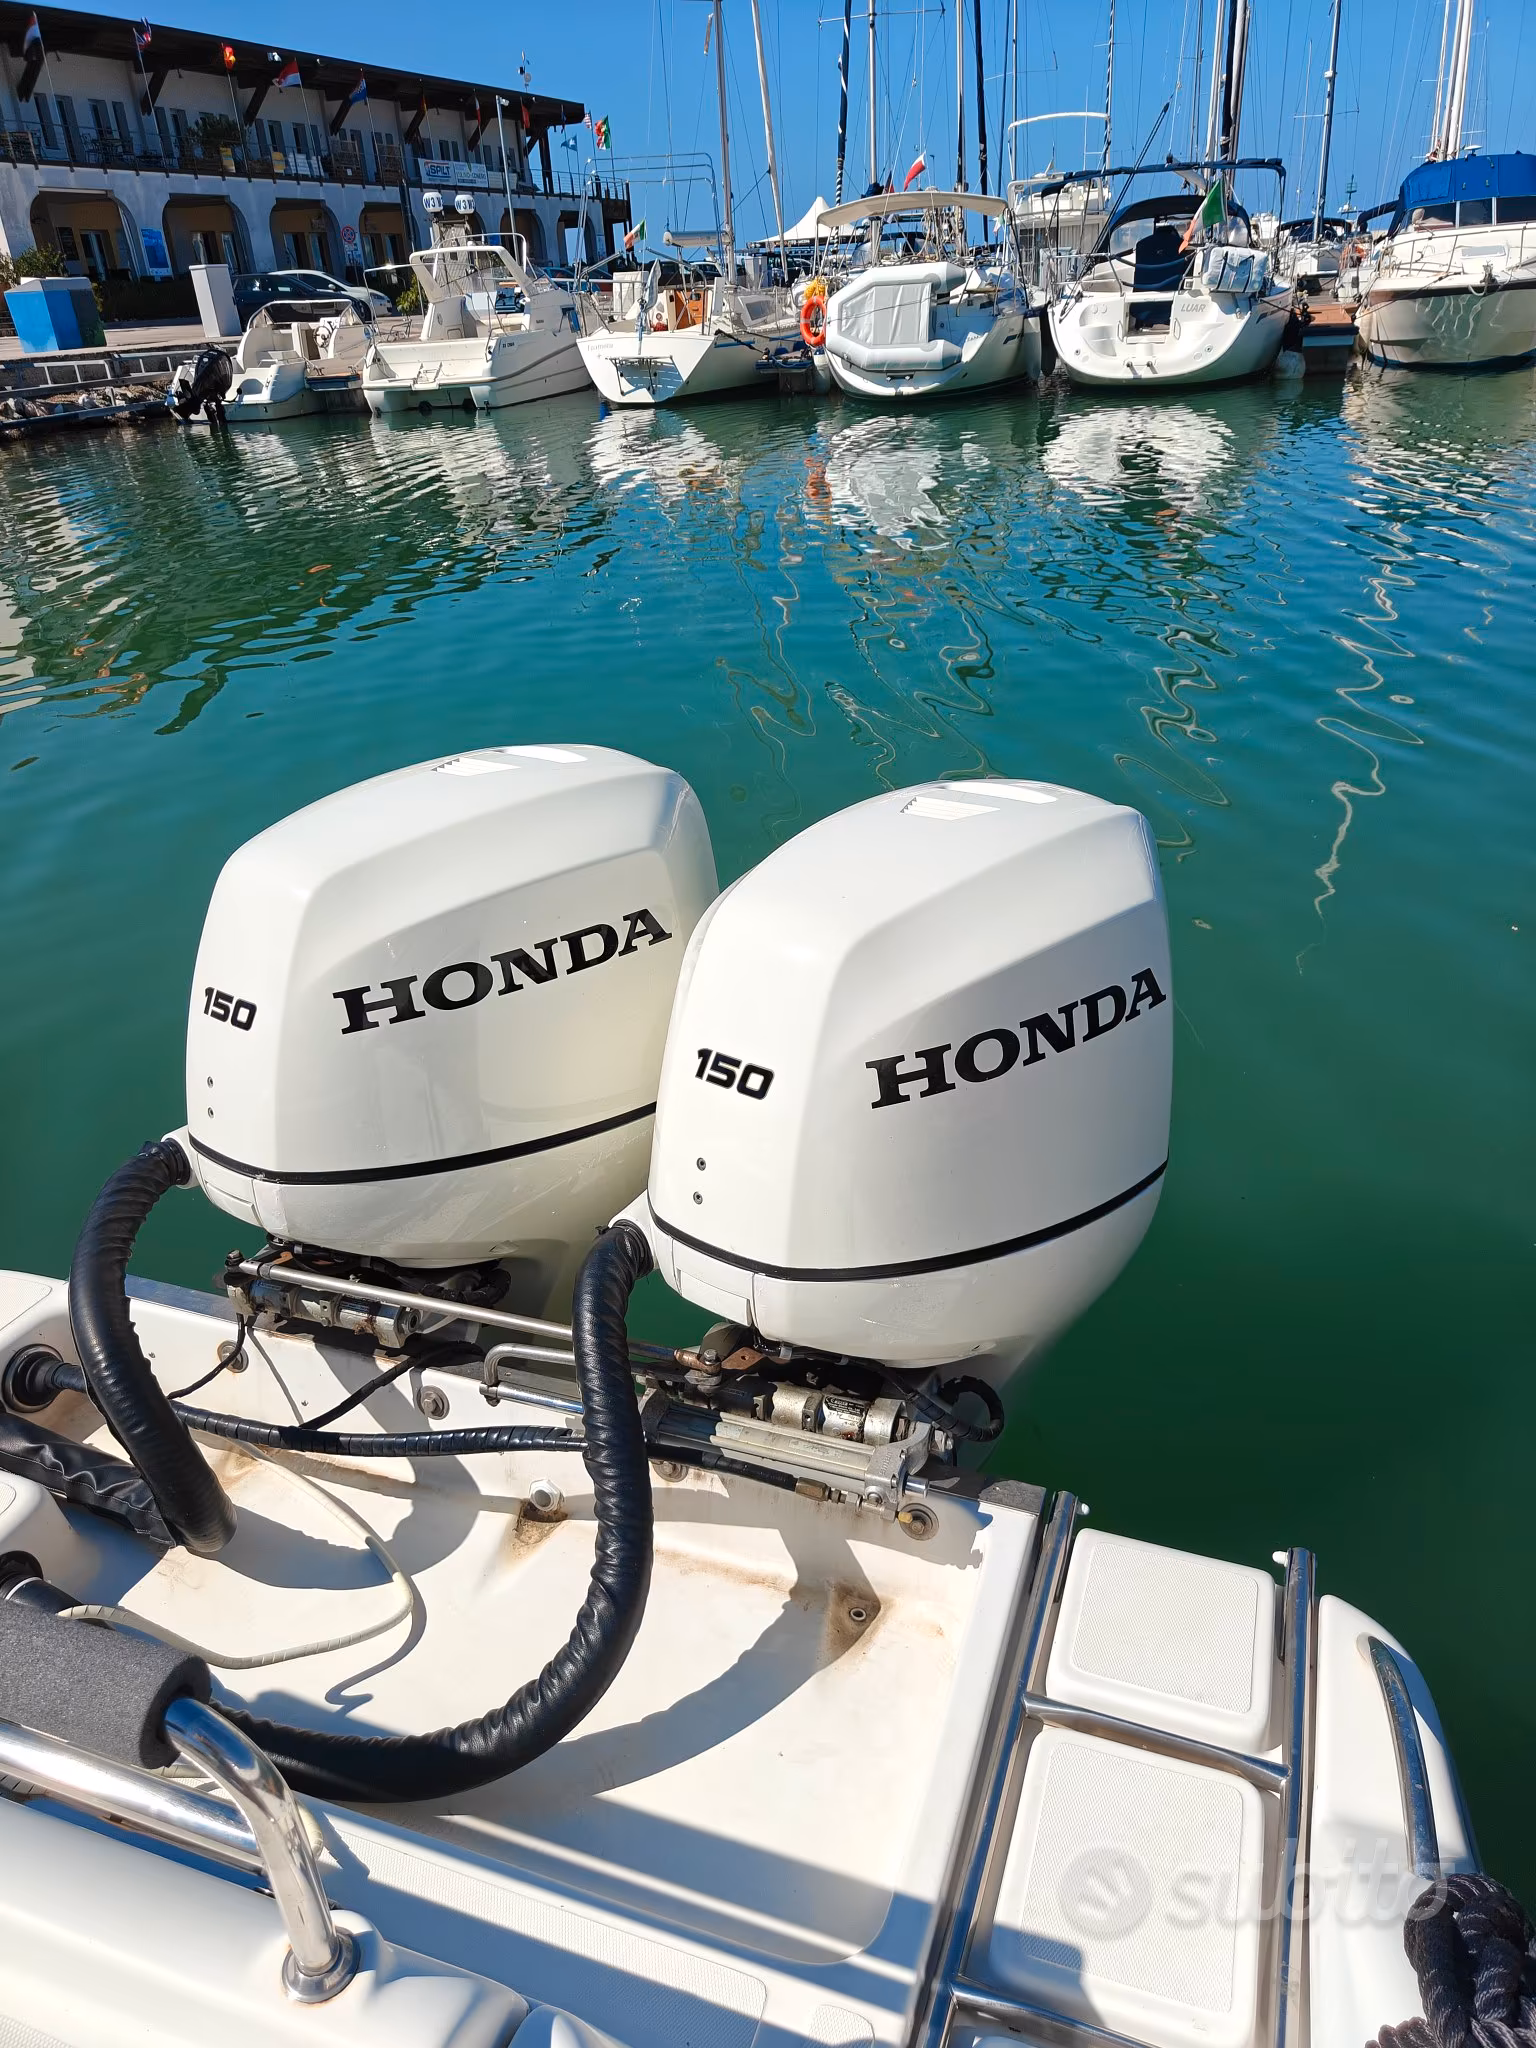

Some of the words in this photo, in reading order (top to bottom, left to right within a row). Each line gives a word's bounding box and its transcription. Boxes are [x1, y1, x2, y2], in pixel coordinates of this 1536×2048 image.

[1180, 304, 1206, 312] LUAR
[333, 908, 672, 1035] HONDA
[203, 986, 257, 1031] 150
[865, 967, 1167, 1109] HONDA
[695, 1048, 775, 1100] 150
